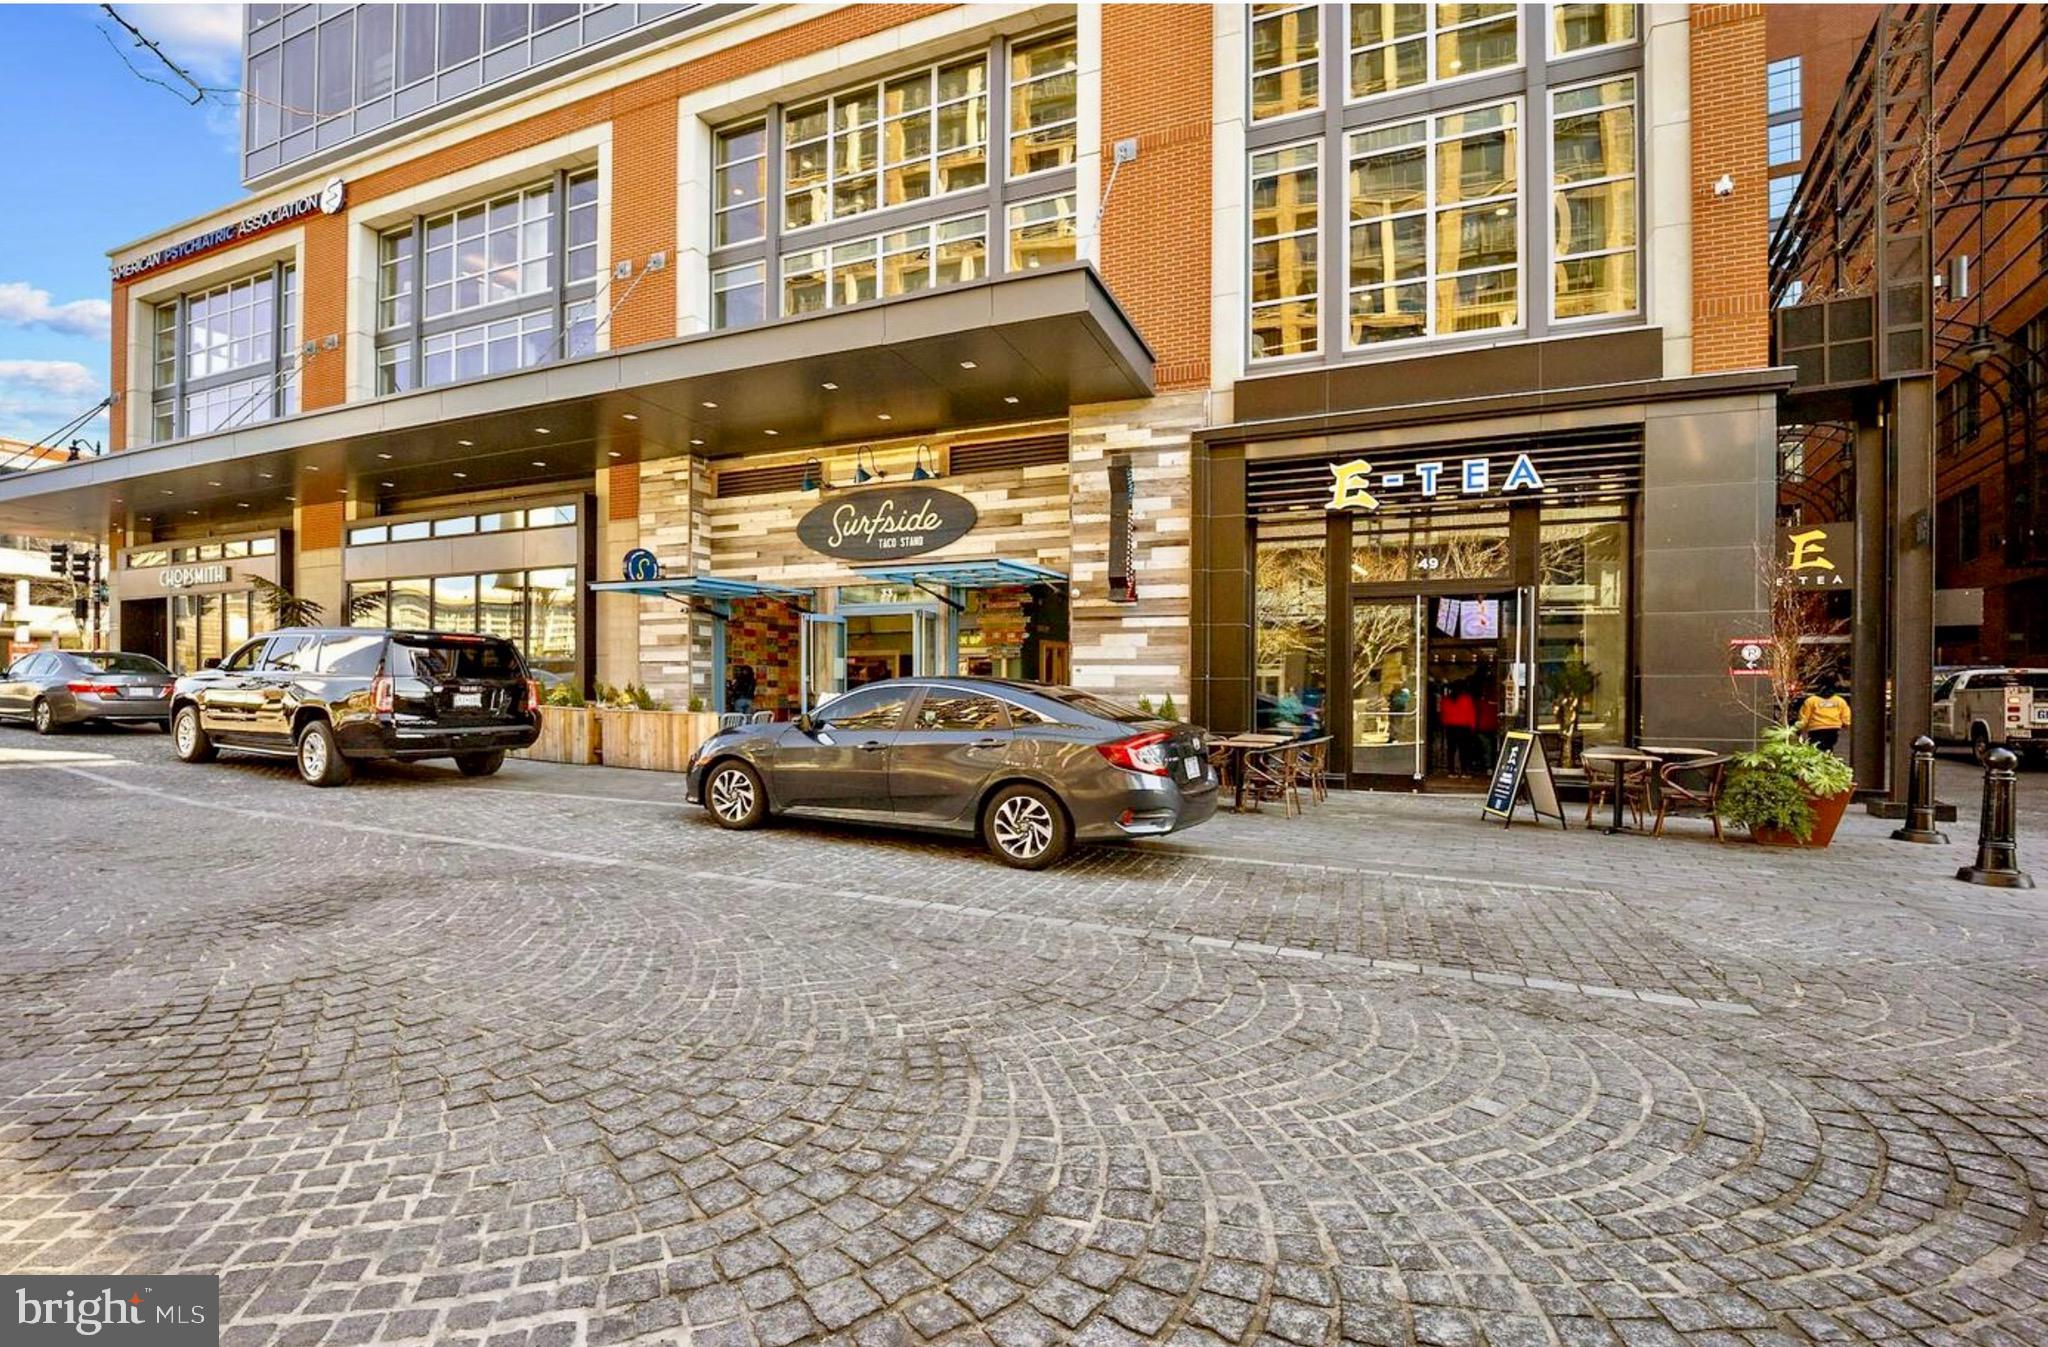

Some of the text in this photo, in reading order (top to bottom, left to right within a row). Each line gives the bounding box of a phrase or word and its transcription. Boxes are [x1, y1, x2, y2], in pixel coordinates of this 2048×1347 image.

[112, 195, 318, 280] AMERICAN PSYCHIATRIC ASSOCIATION
[1324, 453, 1544, 511] E-TEA
[827, 498, 943, 548] Surfside
[878, 535, 924, 549] TACO STAND
[1417, 557, 1439, 570] 49
[1784, 529, 1835, 570] E
[159, 565, 226, 588] CHOPSMITH
